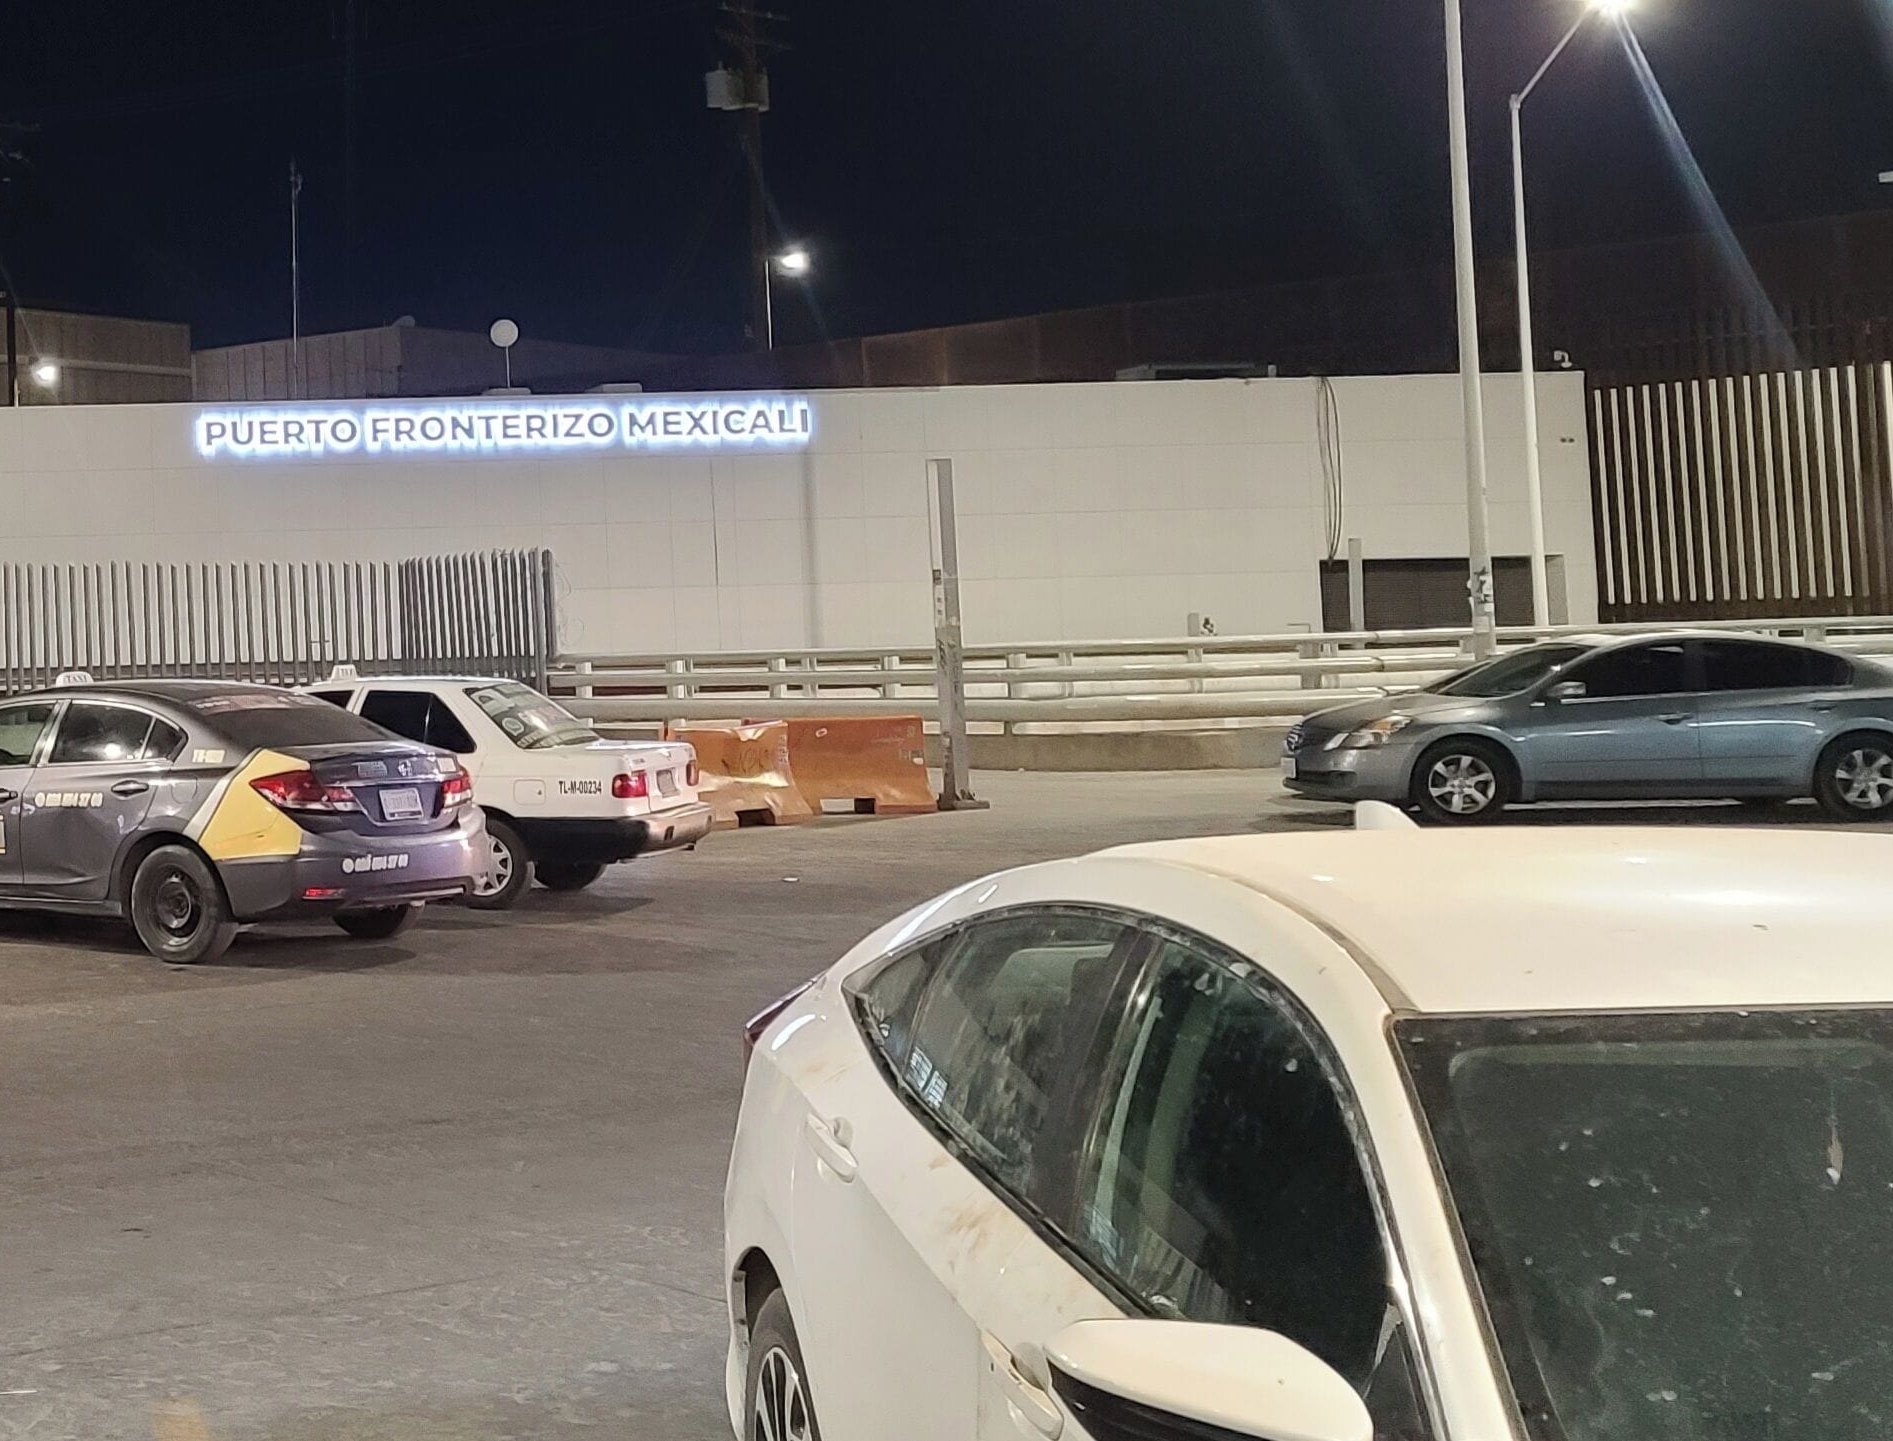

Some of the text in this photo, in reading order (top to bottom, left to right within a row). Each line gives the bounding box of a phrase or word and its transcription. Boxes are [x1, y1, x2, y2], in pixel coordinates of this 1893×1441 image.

[204, 408, 809, 447] PUERTO FRONTERIZO MEXICALI
[63, 674, 88, 684] TAXI
[558, 780, 602, 795] TL-M-00234
